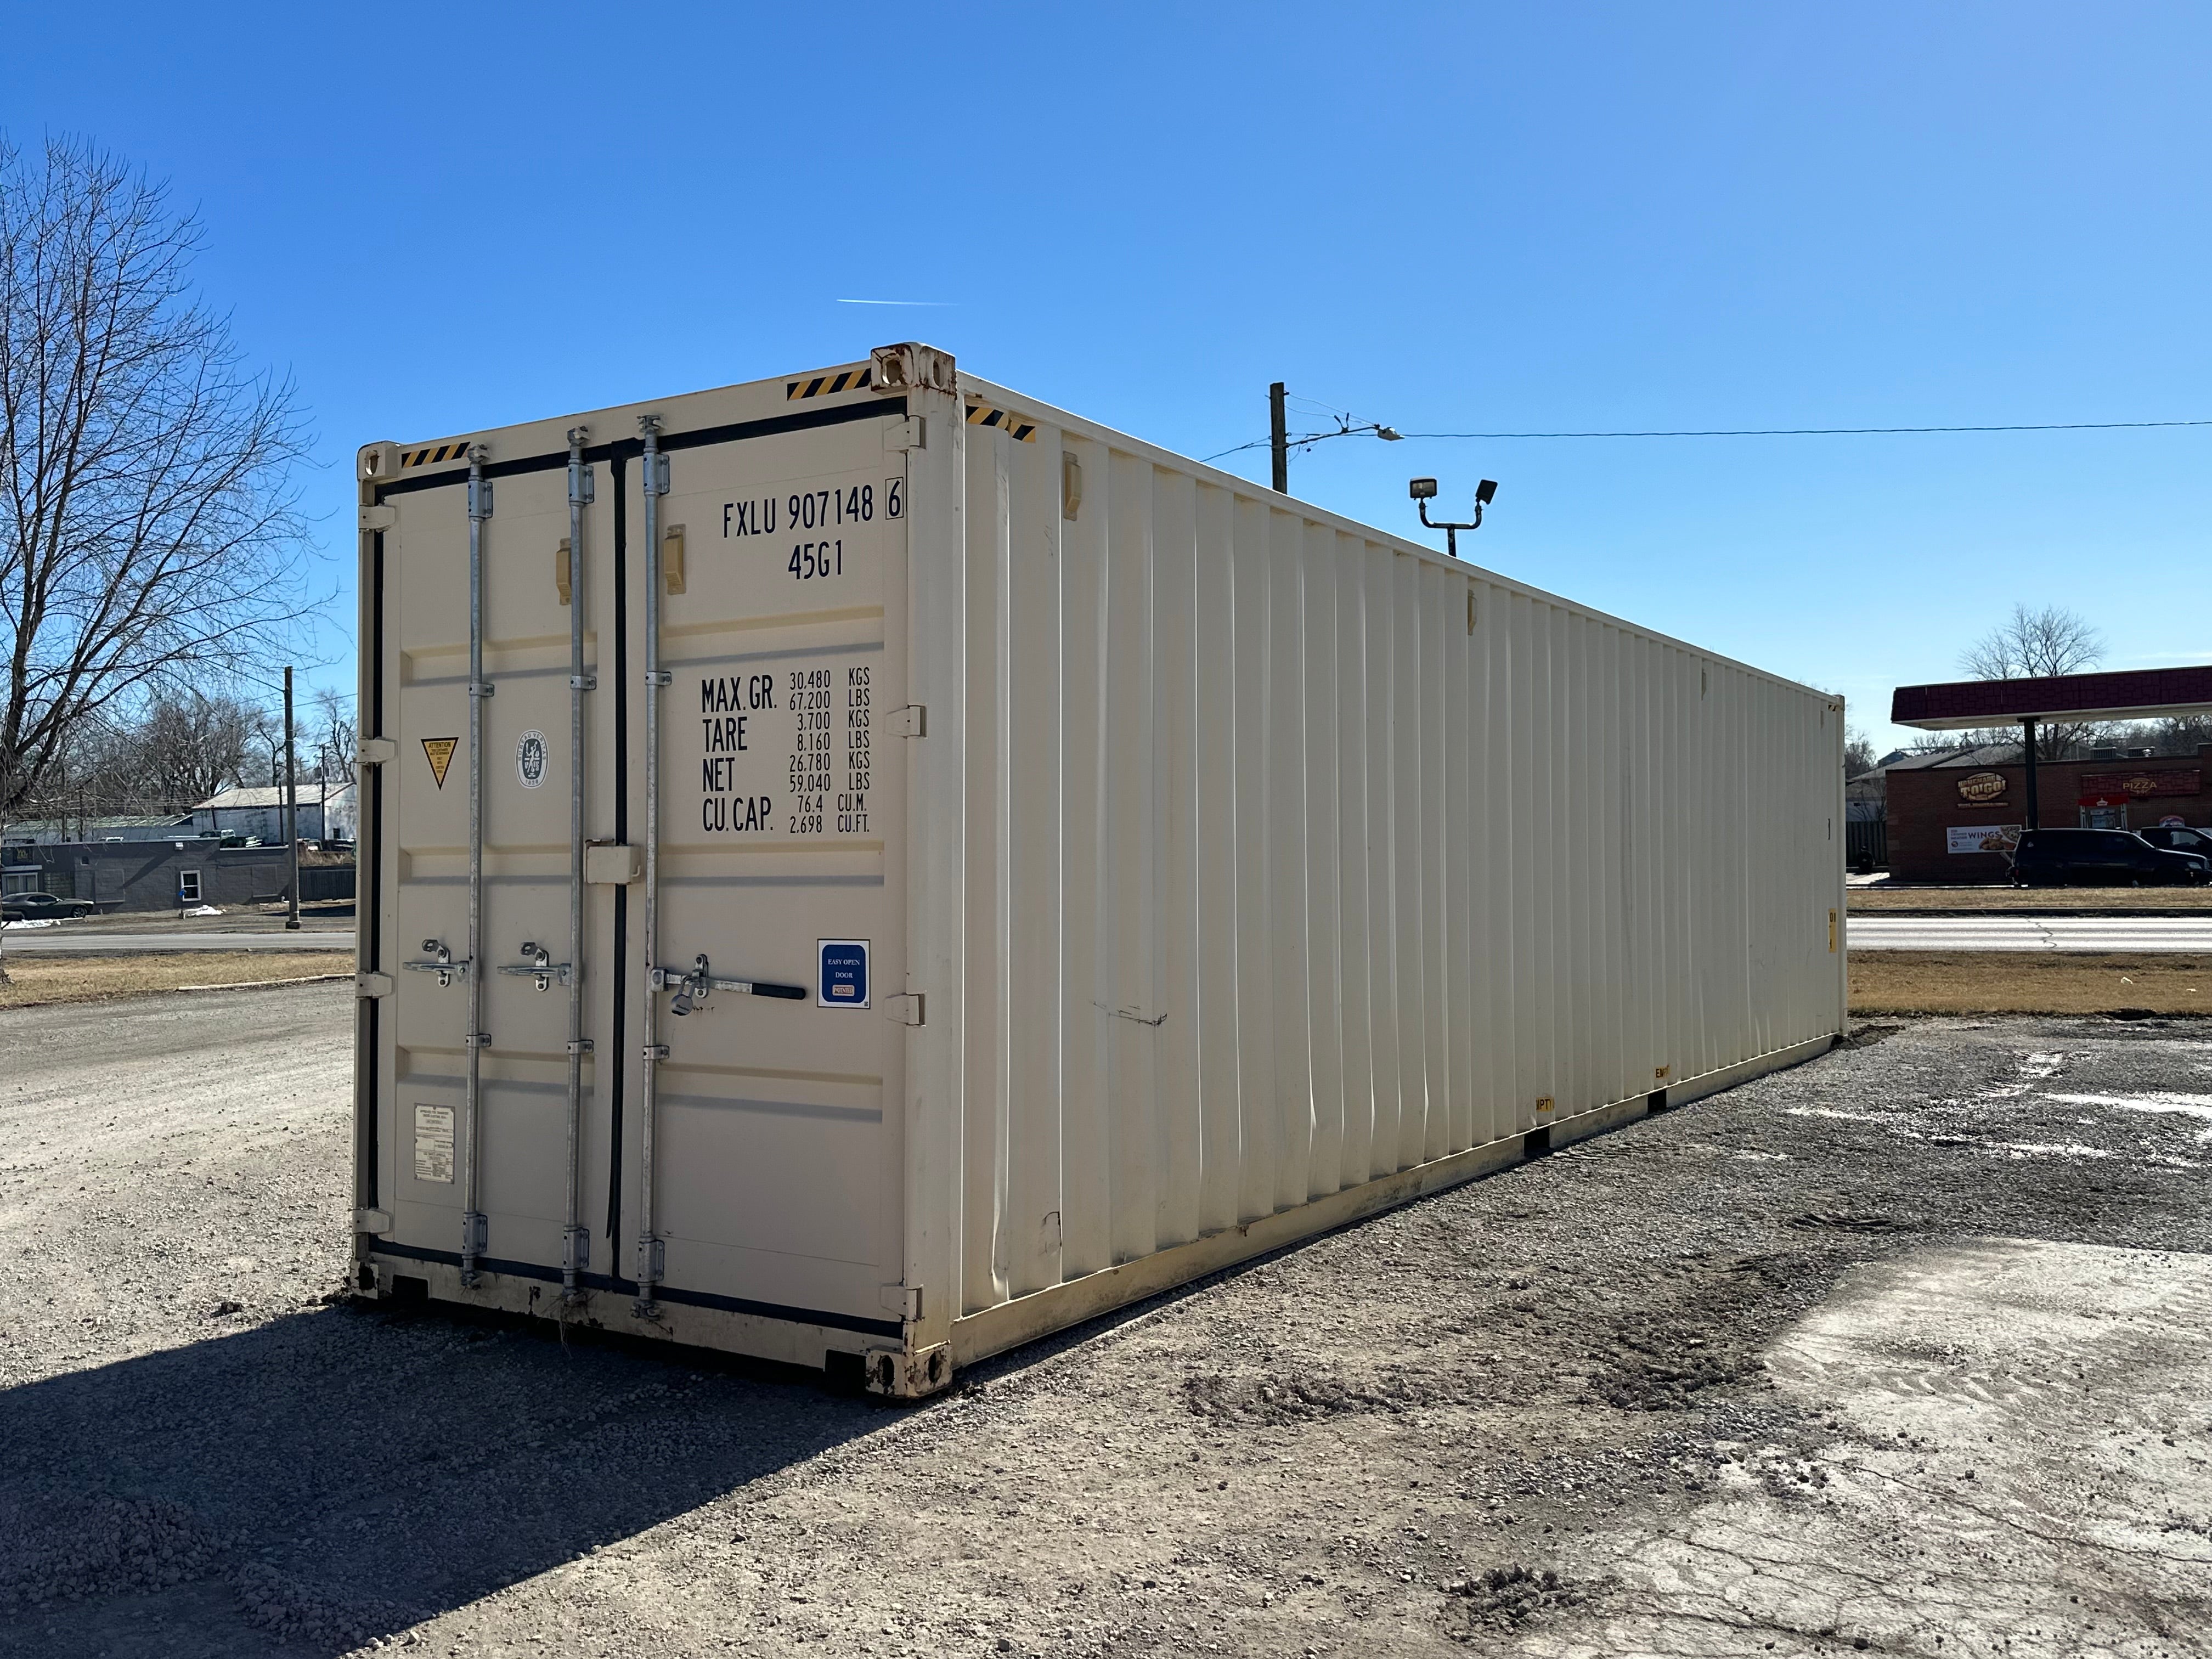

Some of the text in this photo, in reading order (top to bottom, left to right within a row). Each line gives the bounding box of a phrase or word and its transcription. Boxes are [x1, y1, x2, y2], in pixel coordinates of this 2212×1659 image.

[724, 480, 901, 538] FXLU 907148 6
[788, 540, 842, 580] 45G1
[789, 670, 831, 690] 30,480
[849, 667, 870, 686] KGS
[789, 688, 870, 710] 67,200 LBS
[702, 709, 870, 752] TARE 3,700 KGS
[797, 730, 870, 752] 8,160 LBS
[518, 733, 531, 761] BUREAU
[533, 733, 546, 760] VERITAS
[703, 751, 870, 792] NET 26,780 KGS
[789, 771, 870, 793] 59,040 LBS
[2123, 781, 2158, 790] PIZZA
[703, 793, 867, 832] CU.CAP. 76.4 CU.M.
[789, 814, 870, 833] 2,698 CU.FT.
